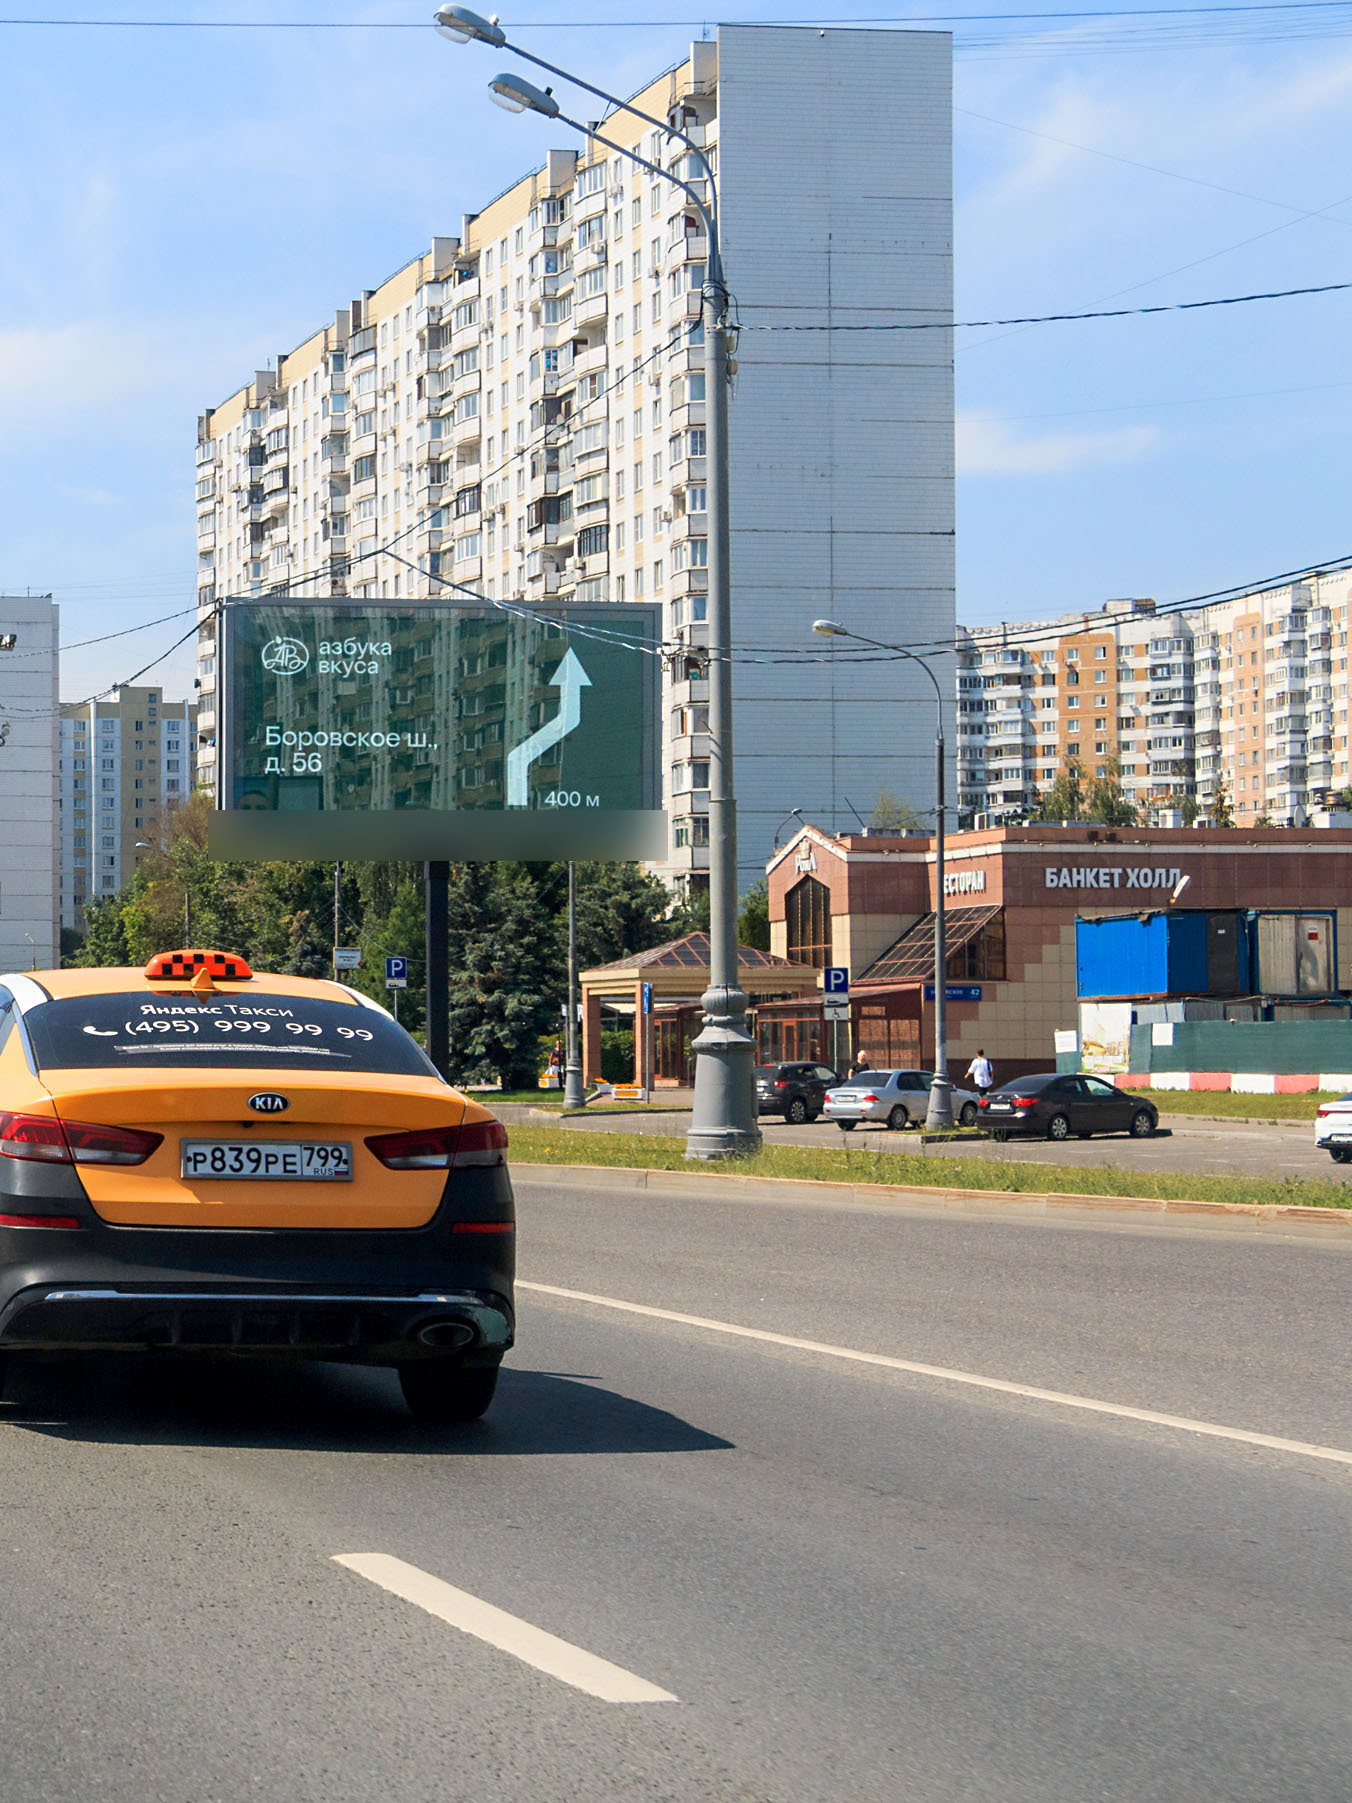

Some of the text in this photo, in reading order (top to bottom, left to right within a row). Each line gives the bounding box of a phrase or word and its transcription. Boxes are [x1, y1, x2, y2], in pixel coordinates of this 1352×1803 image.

[319, 636, 392, 660] азбука
[318, 660, 379, 678] вкуса
[265, 725, 438, 751] Боровское ш.,
[264, 752, 322, 775] д. 56
[544, 791, 600, 807] 400 м
[943, 870, 985, 894] ЕСТОРАН
[1045, 867, 1181, 889] БАНКЕТ ХОЛЛ
[391, 959, 403, 977] P
[830, 970, 845, 991] P
[969, 988, 980, 996] 42
[140, 1004, 294, 1018] Яндекс Такси
[124, 1019, 374, 1041] (495) 999 99 99
[255, 1097, 284, 1110] KIA
[192, 1146, 343, 1174] Р839РЕ 799
[313, 1167, 334, 1176] RUS
